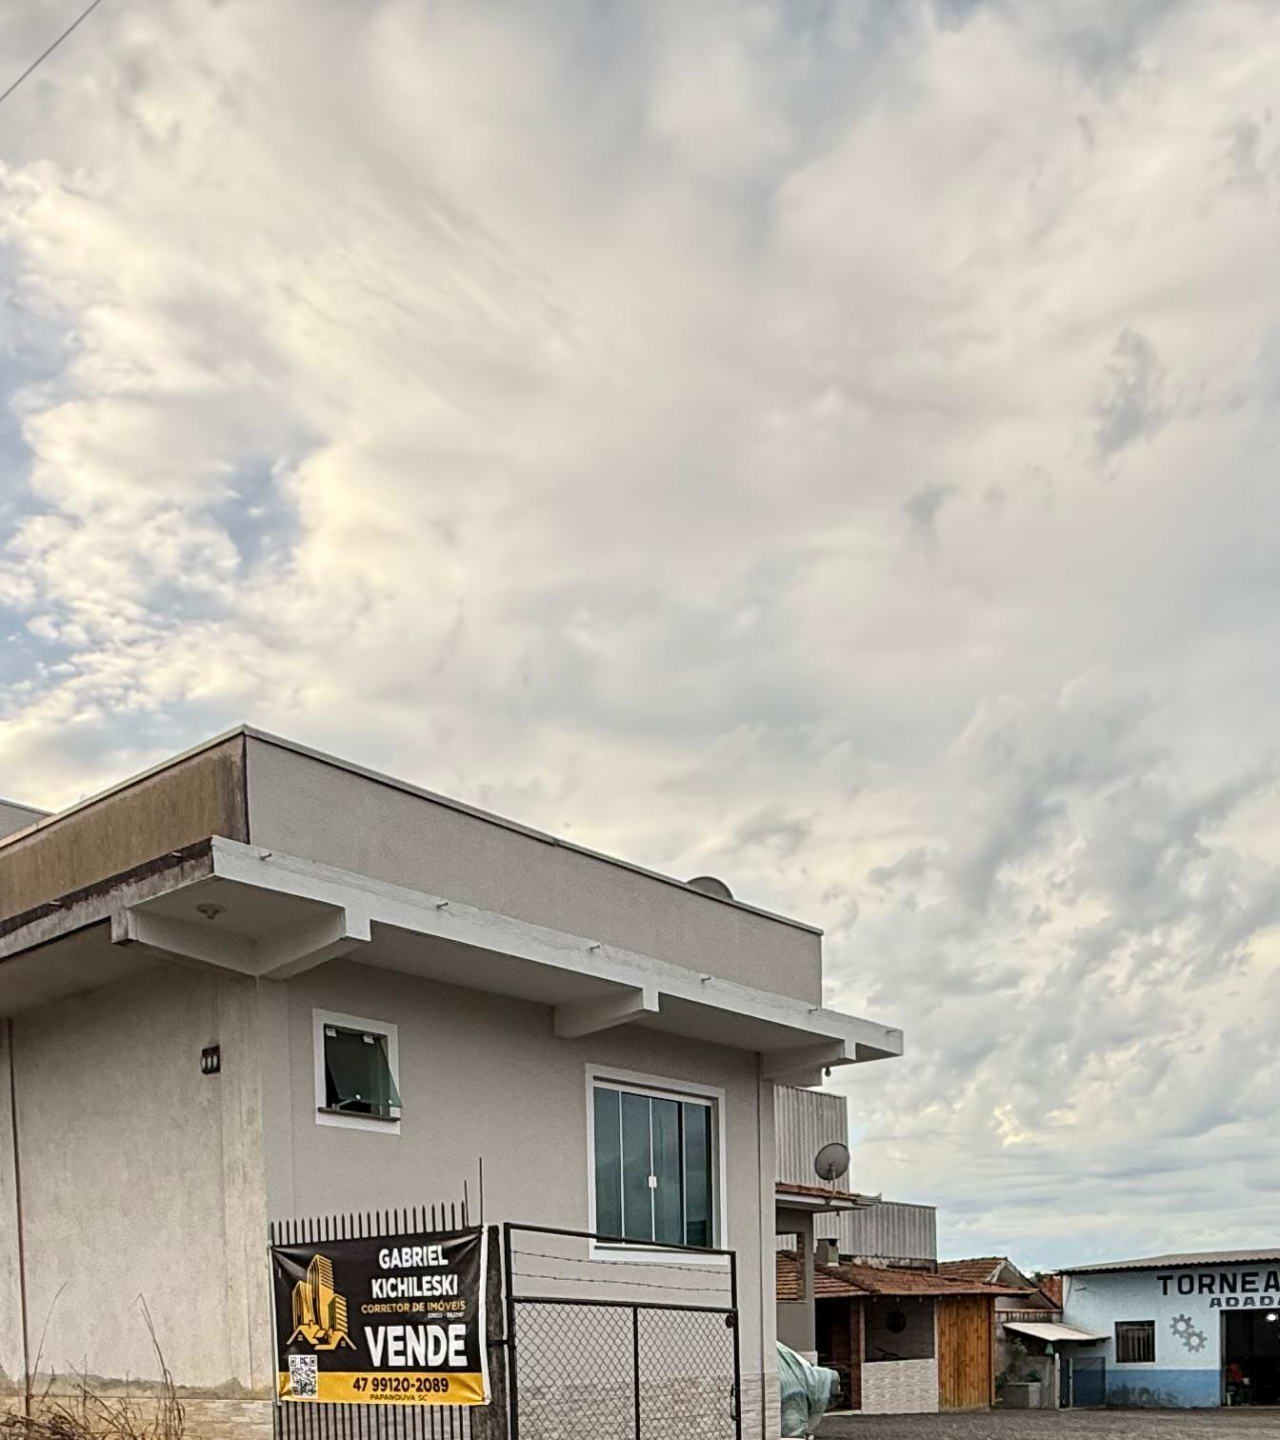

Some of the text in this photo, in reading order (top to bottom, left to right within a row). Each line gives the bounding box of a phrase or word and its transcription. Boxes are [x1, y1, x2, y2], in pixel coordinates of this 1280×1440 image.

[379, 1245, 449, 1269] GABRIEL
[371, 1274, 458, 1299] KICHILESKI
[361, 1302, 410, 1314] CORRETOR
[412, 1302, 426, 1312] DE
[364, 1323, 468, 1367] VENDE
[353, 1377, 449, 1393] 47 99120-2089
